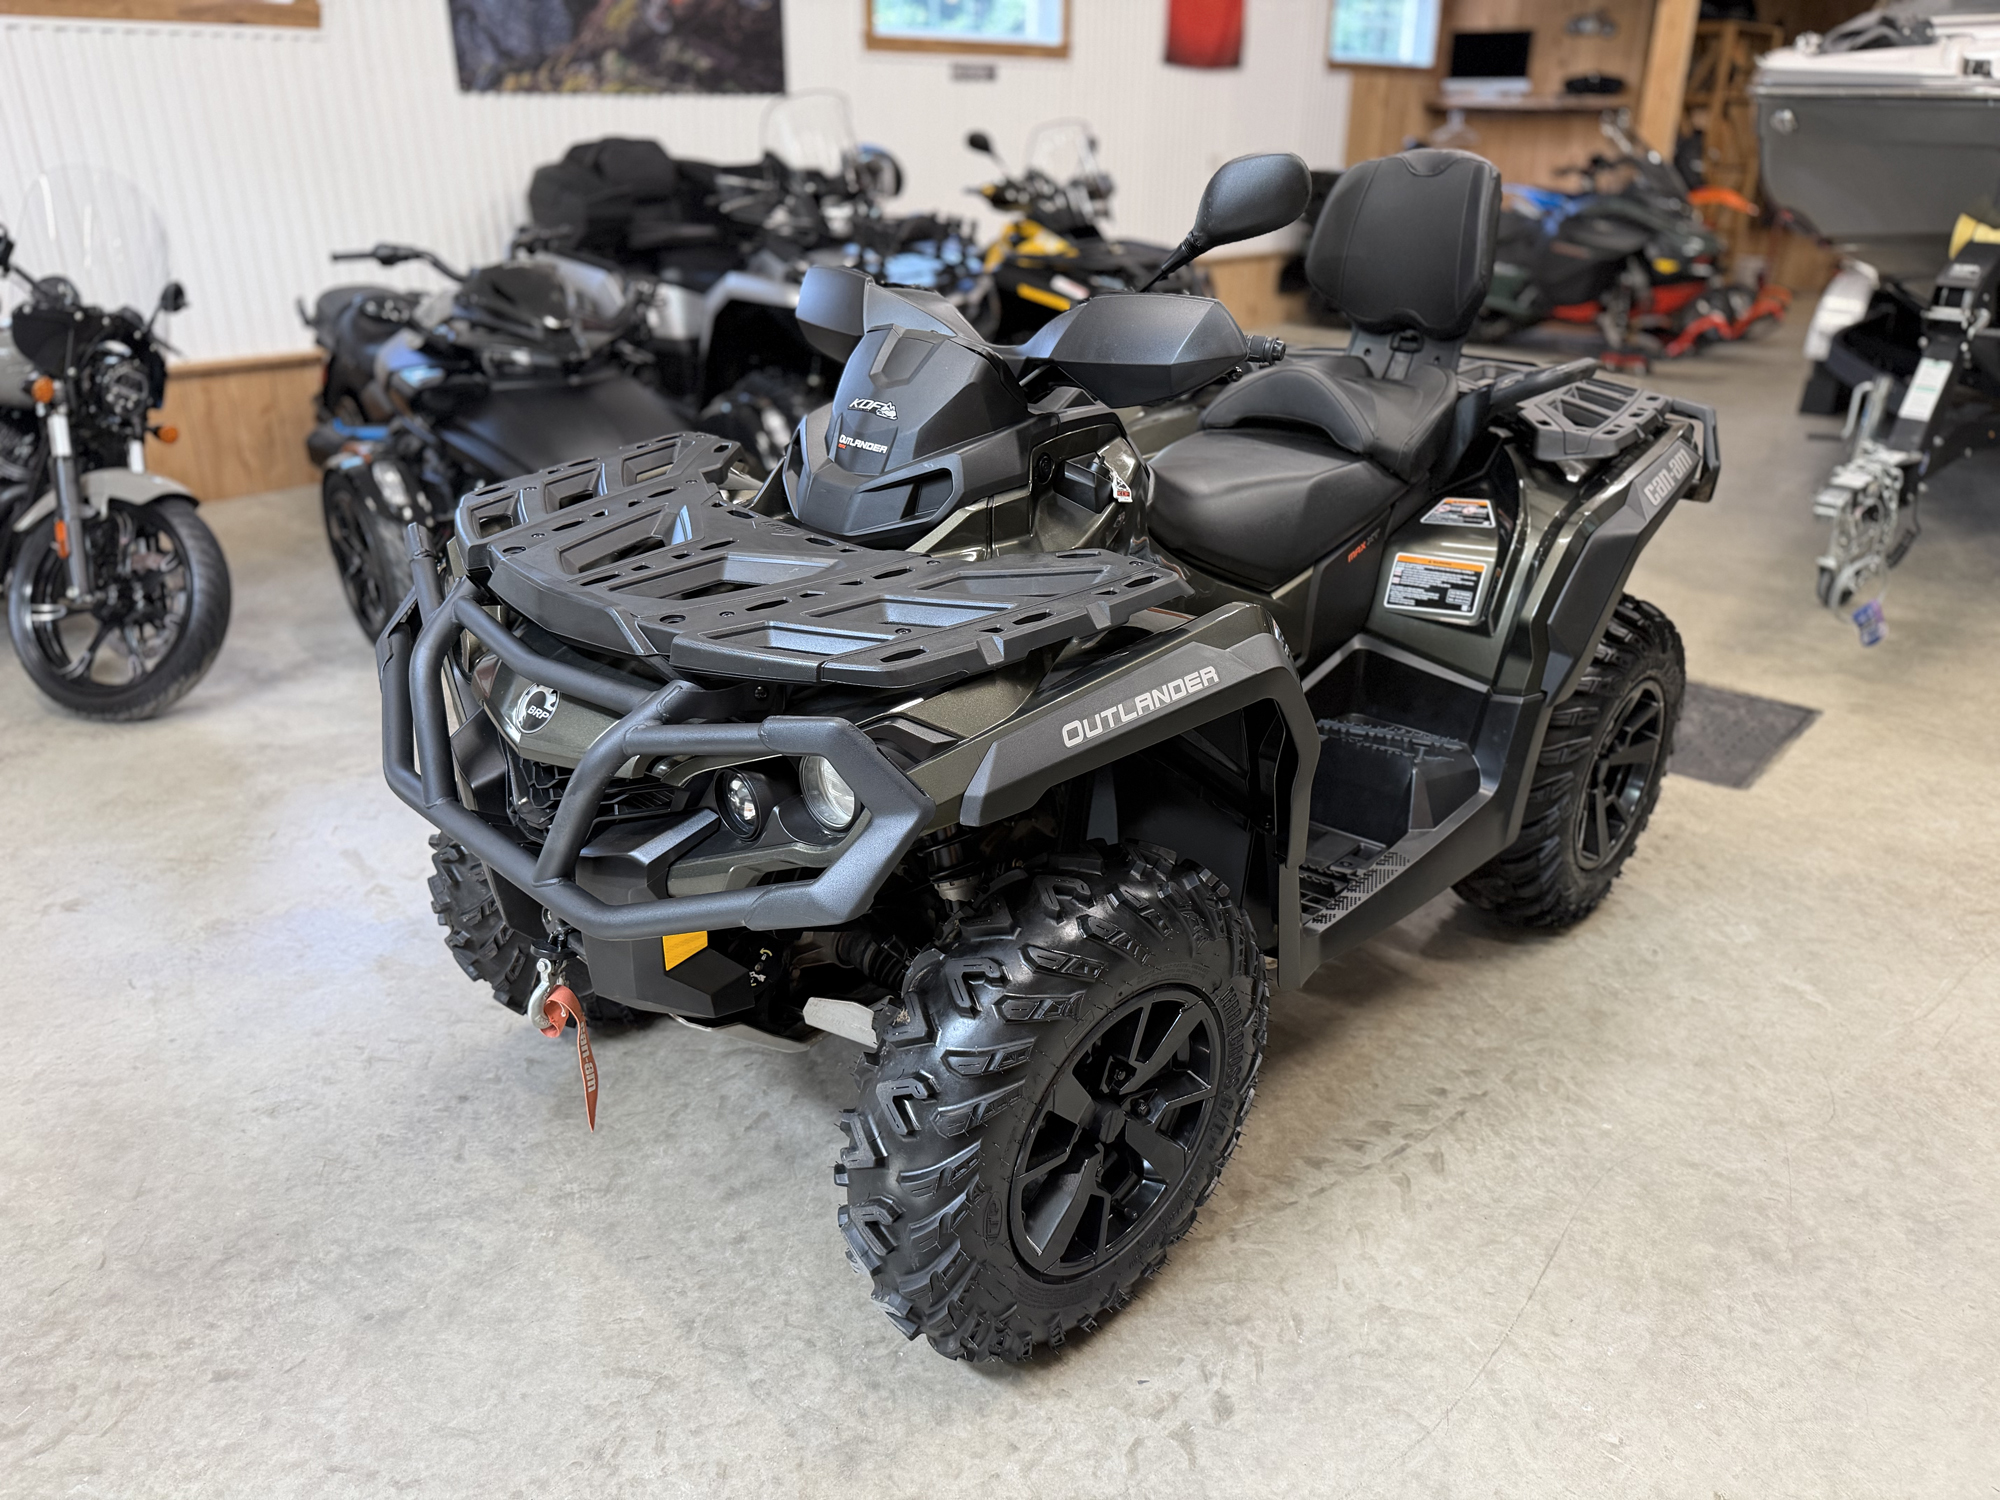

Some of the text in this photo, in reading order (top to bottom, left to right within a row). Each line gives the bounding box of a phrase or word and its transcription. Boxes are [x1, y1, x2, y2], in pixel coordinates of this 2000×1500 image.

[848, 398, 887, 410] KDF
[839, 434, 888, 454] OUTLANDER
[1643, 448, 1693, 506] can-am
[527, 705, 550, 720] BRP
[1062, 665, 1220, 748] OUTLANDER
